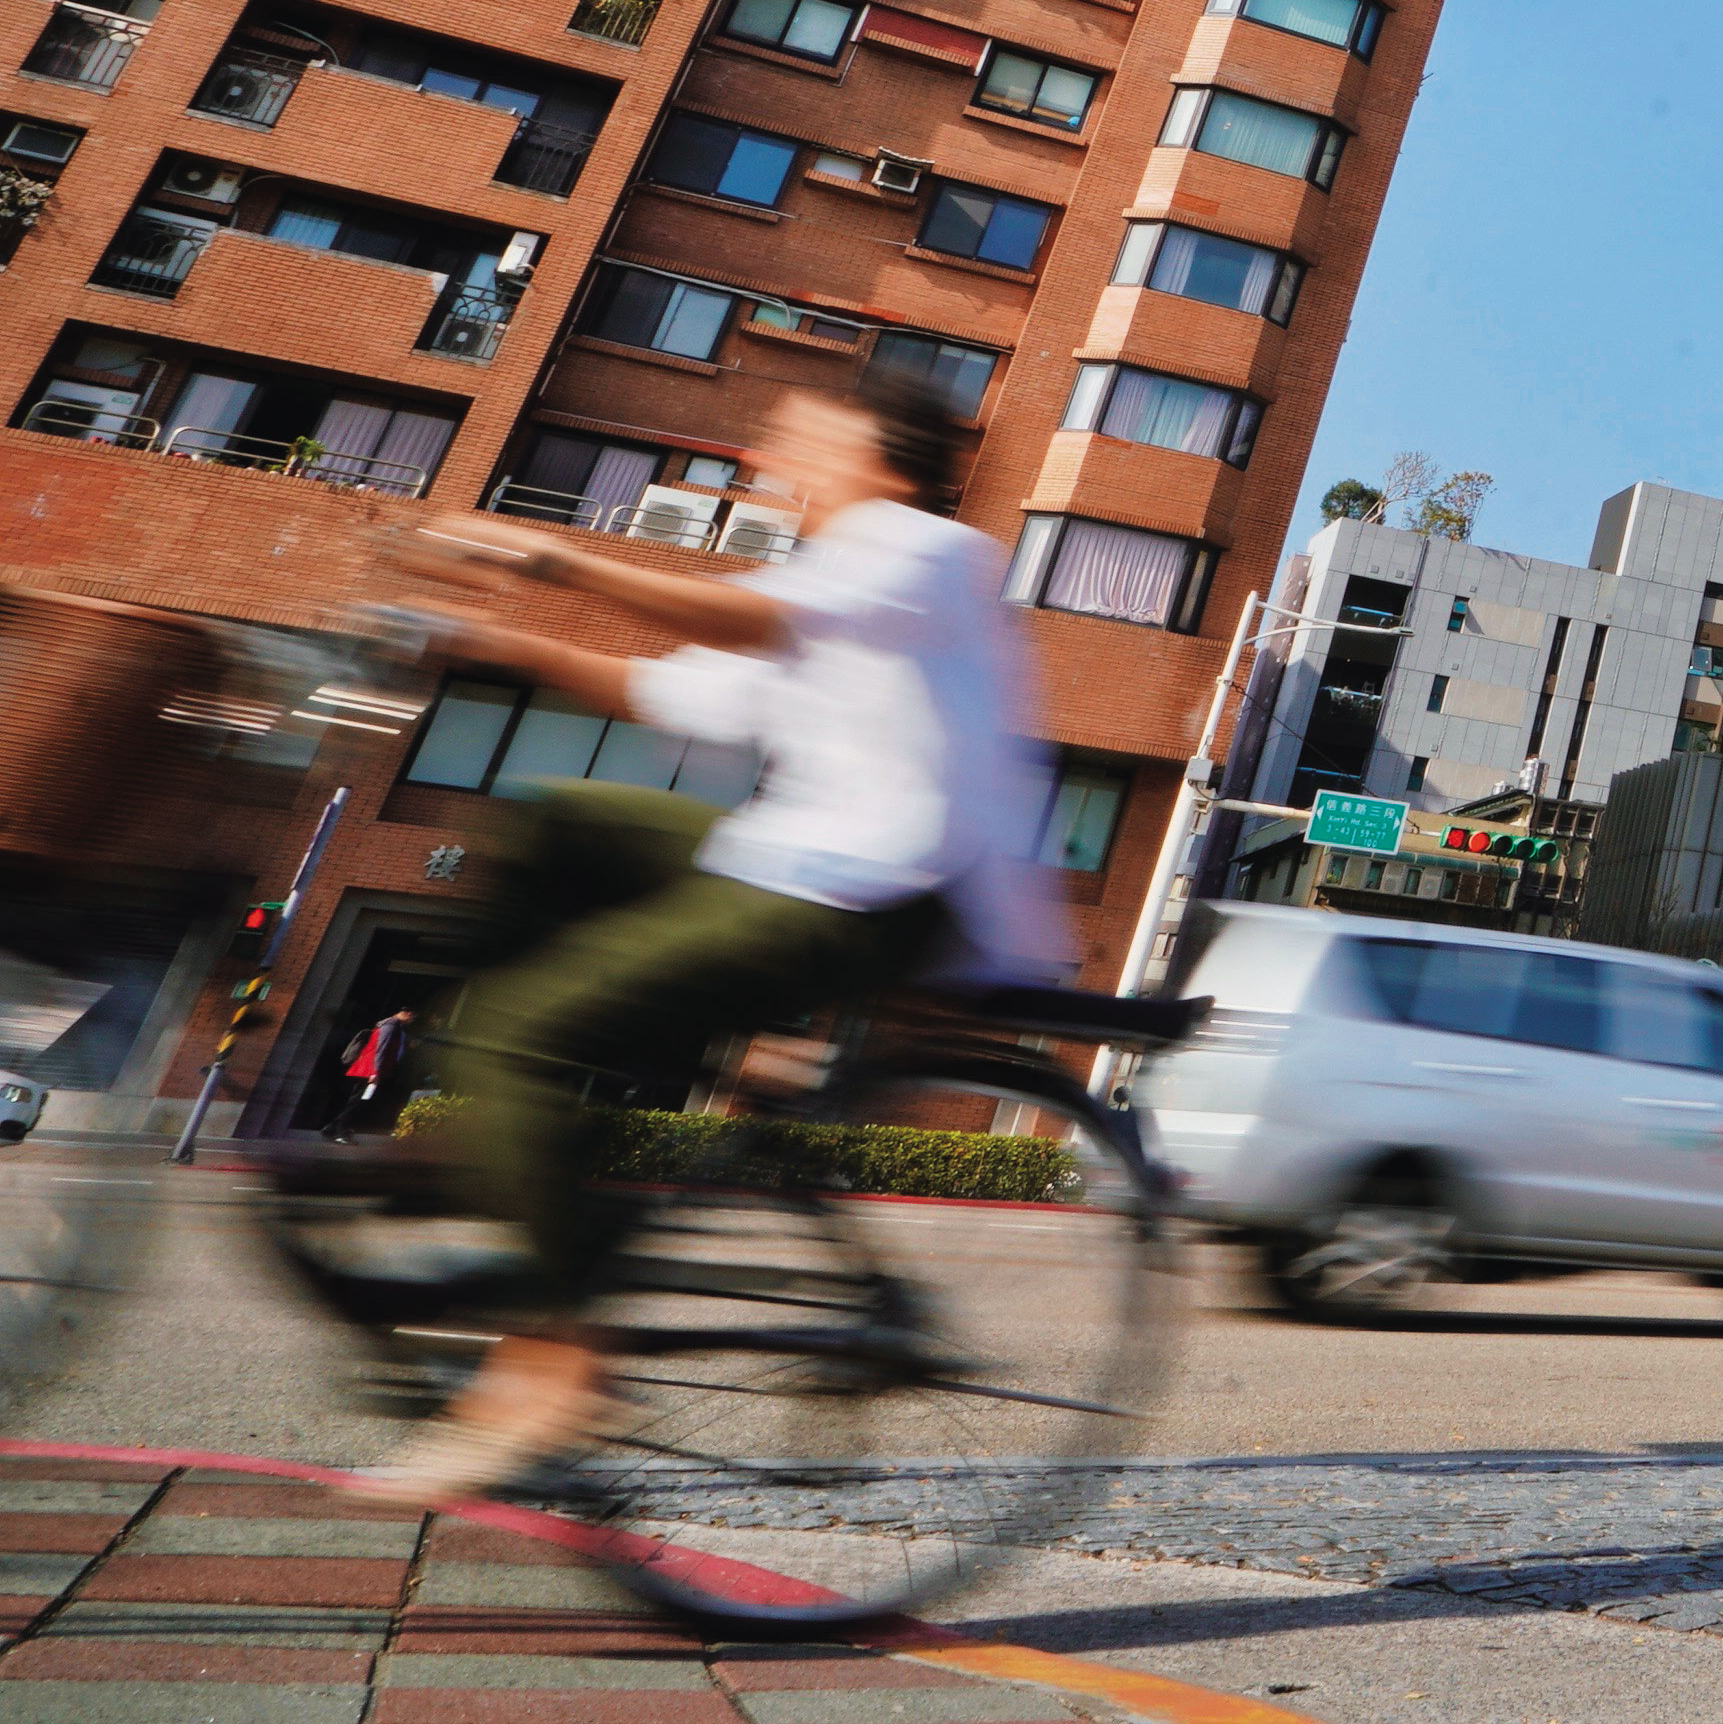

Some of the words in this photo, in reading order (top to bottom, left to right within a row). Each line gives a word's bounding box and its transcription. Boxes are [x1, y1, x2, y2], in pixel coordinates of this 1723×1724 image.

[1326, 798, 1396, 819] 信義路三段
